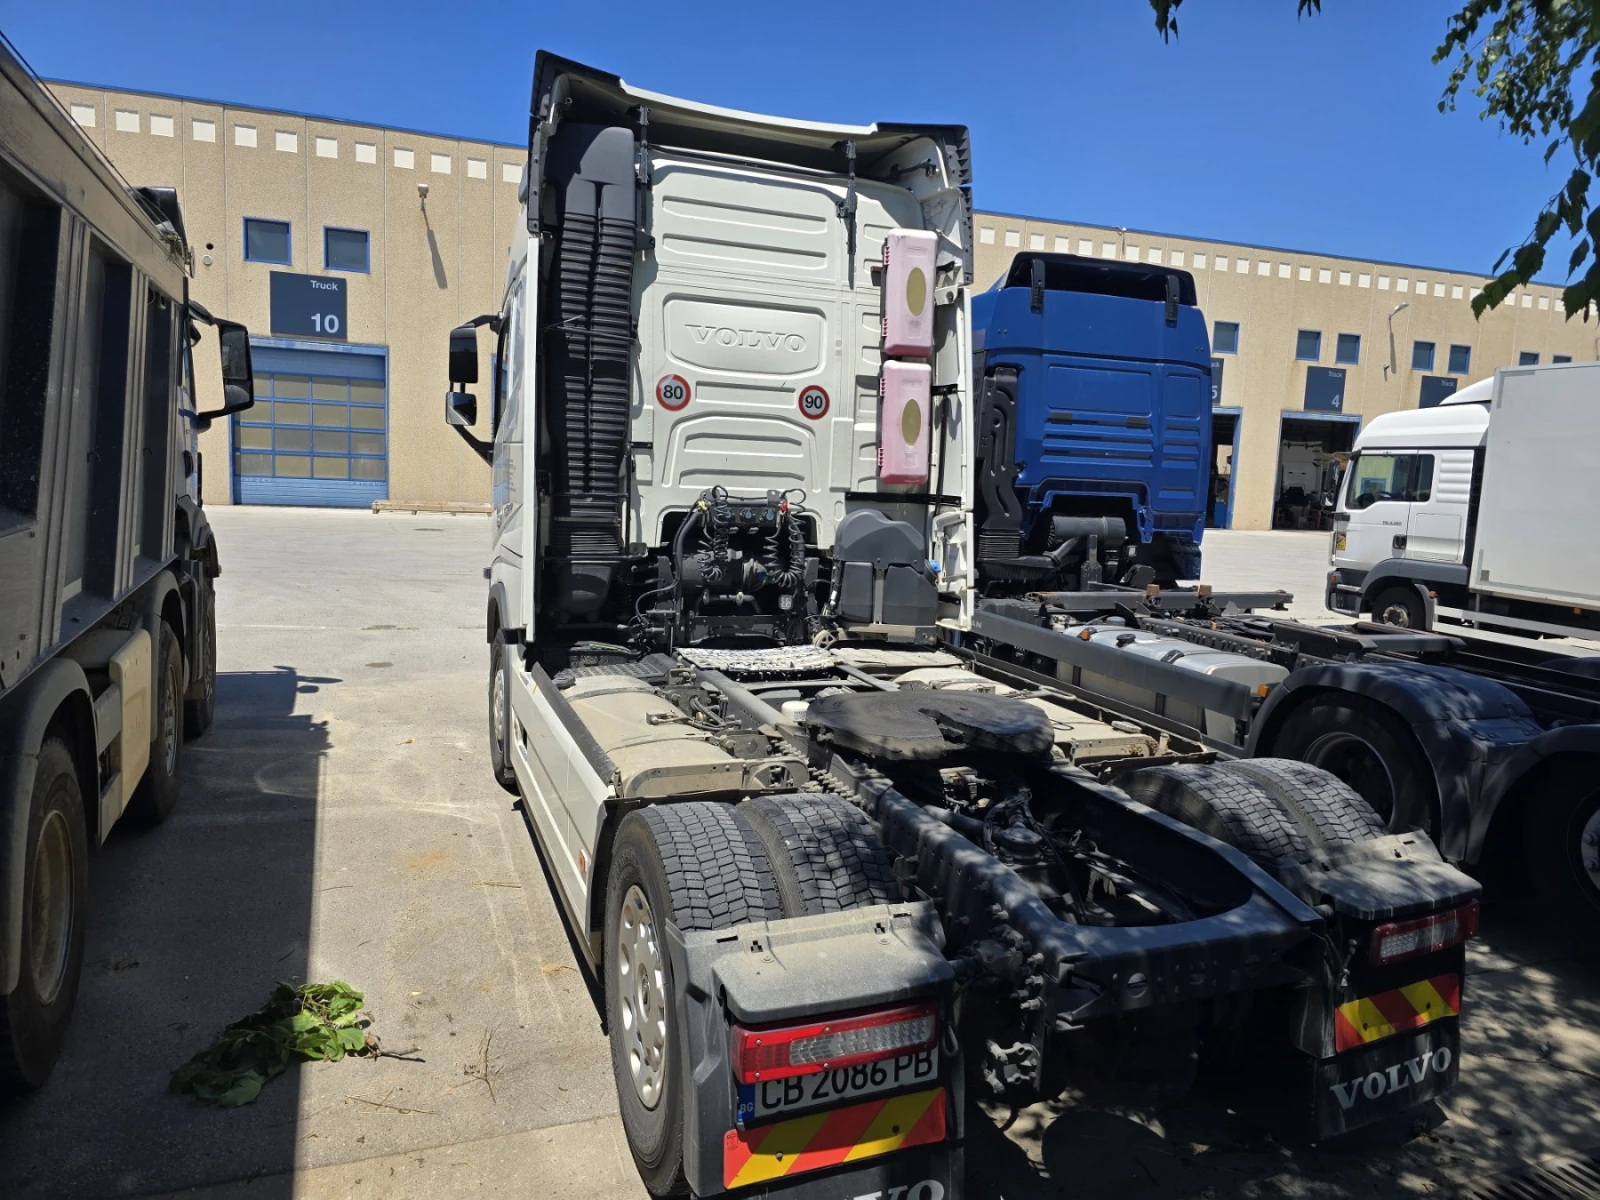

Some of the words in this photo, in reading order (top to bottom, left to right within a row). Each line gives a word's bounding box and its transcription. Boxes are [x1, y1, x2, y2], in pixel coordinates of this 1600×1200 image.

[310, 280, 338, 291] Truck
[311, 313, 339, 334] 10
[684, 323, 807, 353] VOLVO
[1328, 370, 1343, 378] Truck
[663, 384, 684, 400] 80
[804, 394, 823, 409] 90
[1331, 394, 1340, 408] 4
[761, 1076, 804, 1109] CB
[811, 1061, 887, 1100] 2086
[893, 1051, 933, 1083] PB
[1330, 1046, 1452, 1110] VOLVO
[740, 1102, 754, 1114] BG
